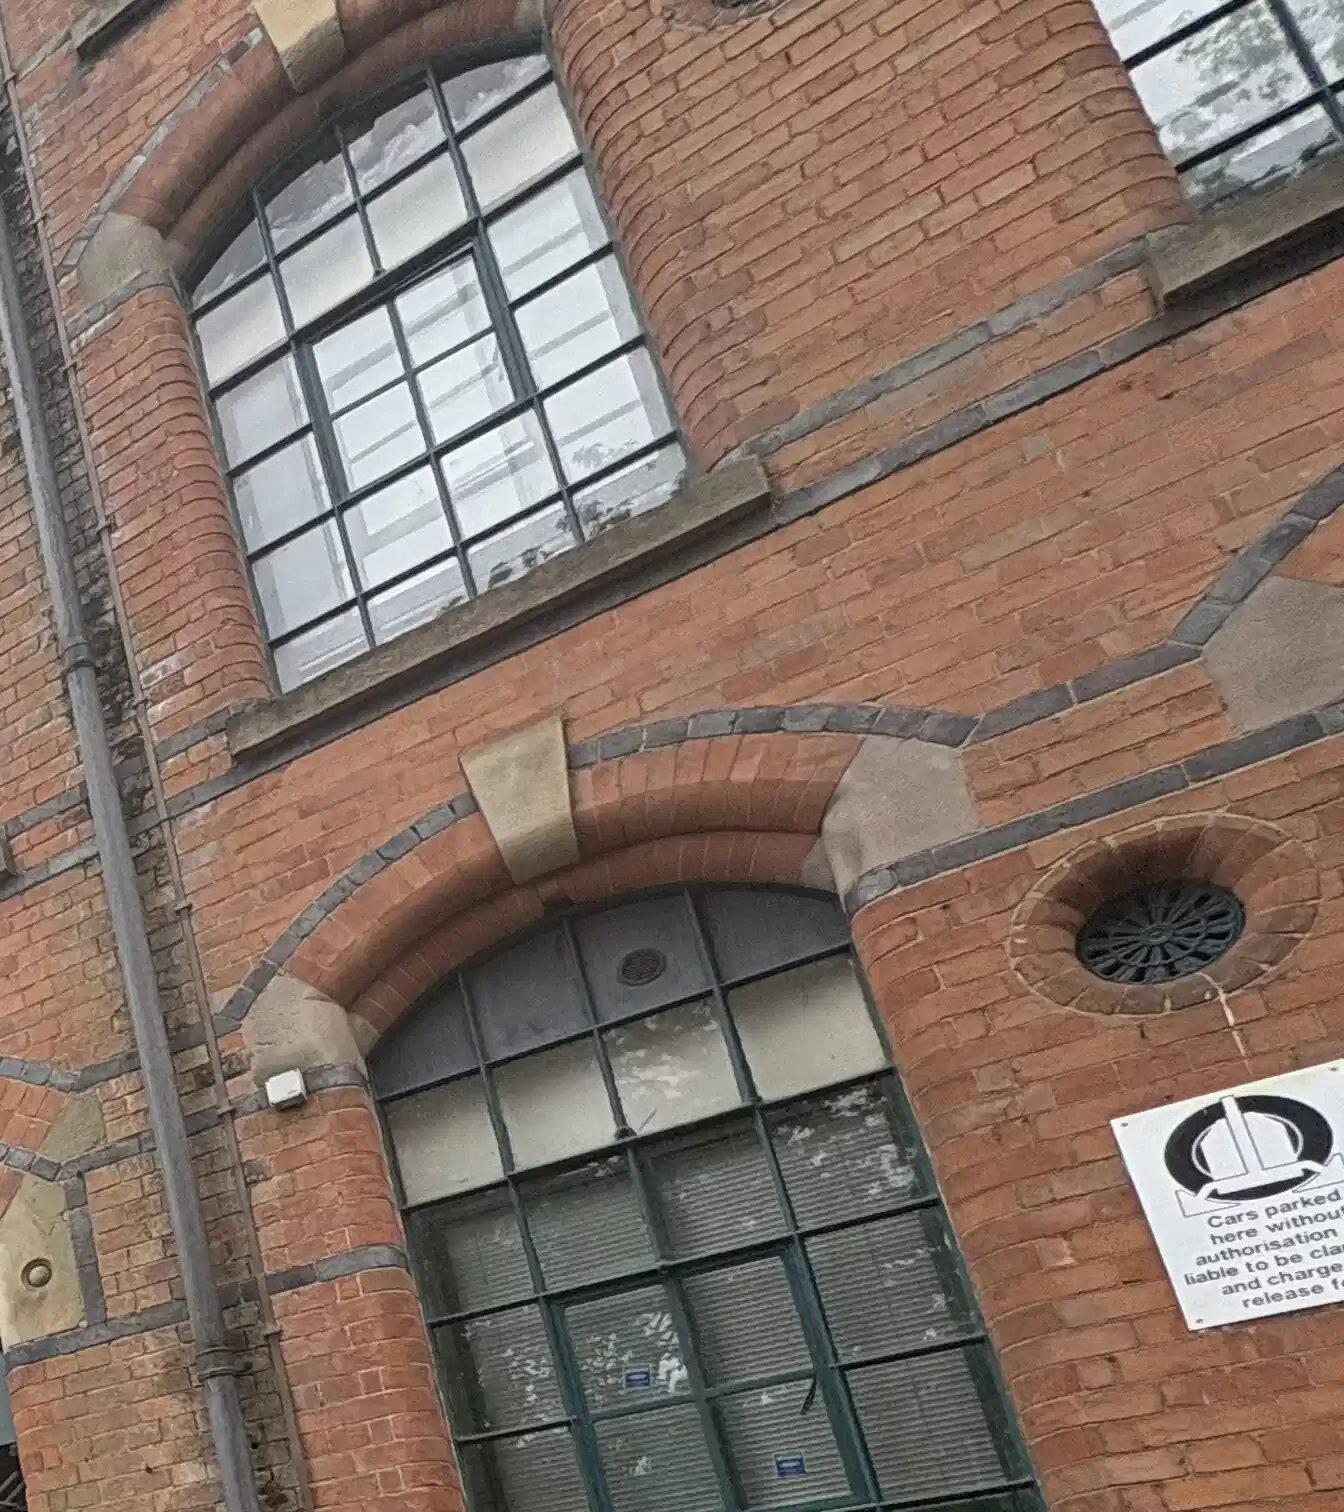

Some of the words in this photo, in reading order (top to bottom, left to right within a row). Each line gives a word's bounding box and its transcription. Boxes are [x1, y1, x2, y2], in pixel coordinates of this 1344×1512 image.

[1206, 1210, 1259, 1229] Cars
[1264, 1188, 1342, 1218] parked
[1195, 1227, 1339, 1266] authorisation
[1209, 1228, 1259, 1246] here
[1183, 1266, 1239, 1286] liable
[1245, 1260, 1269, 1273] to
[1274, 1253, 1304, 1267] be
[1221, 1277, 1262, 1296] and
[1242, 1283, 1325, 1309] release
